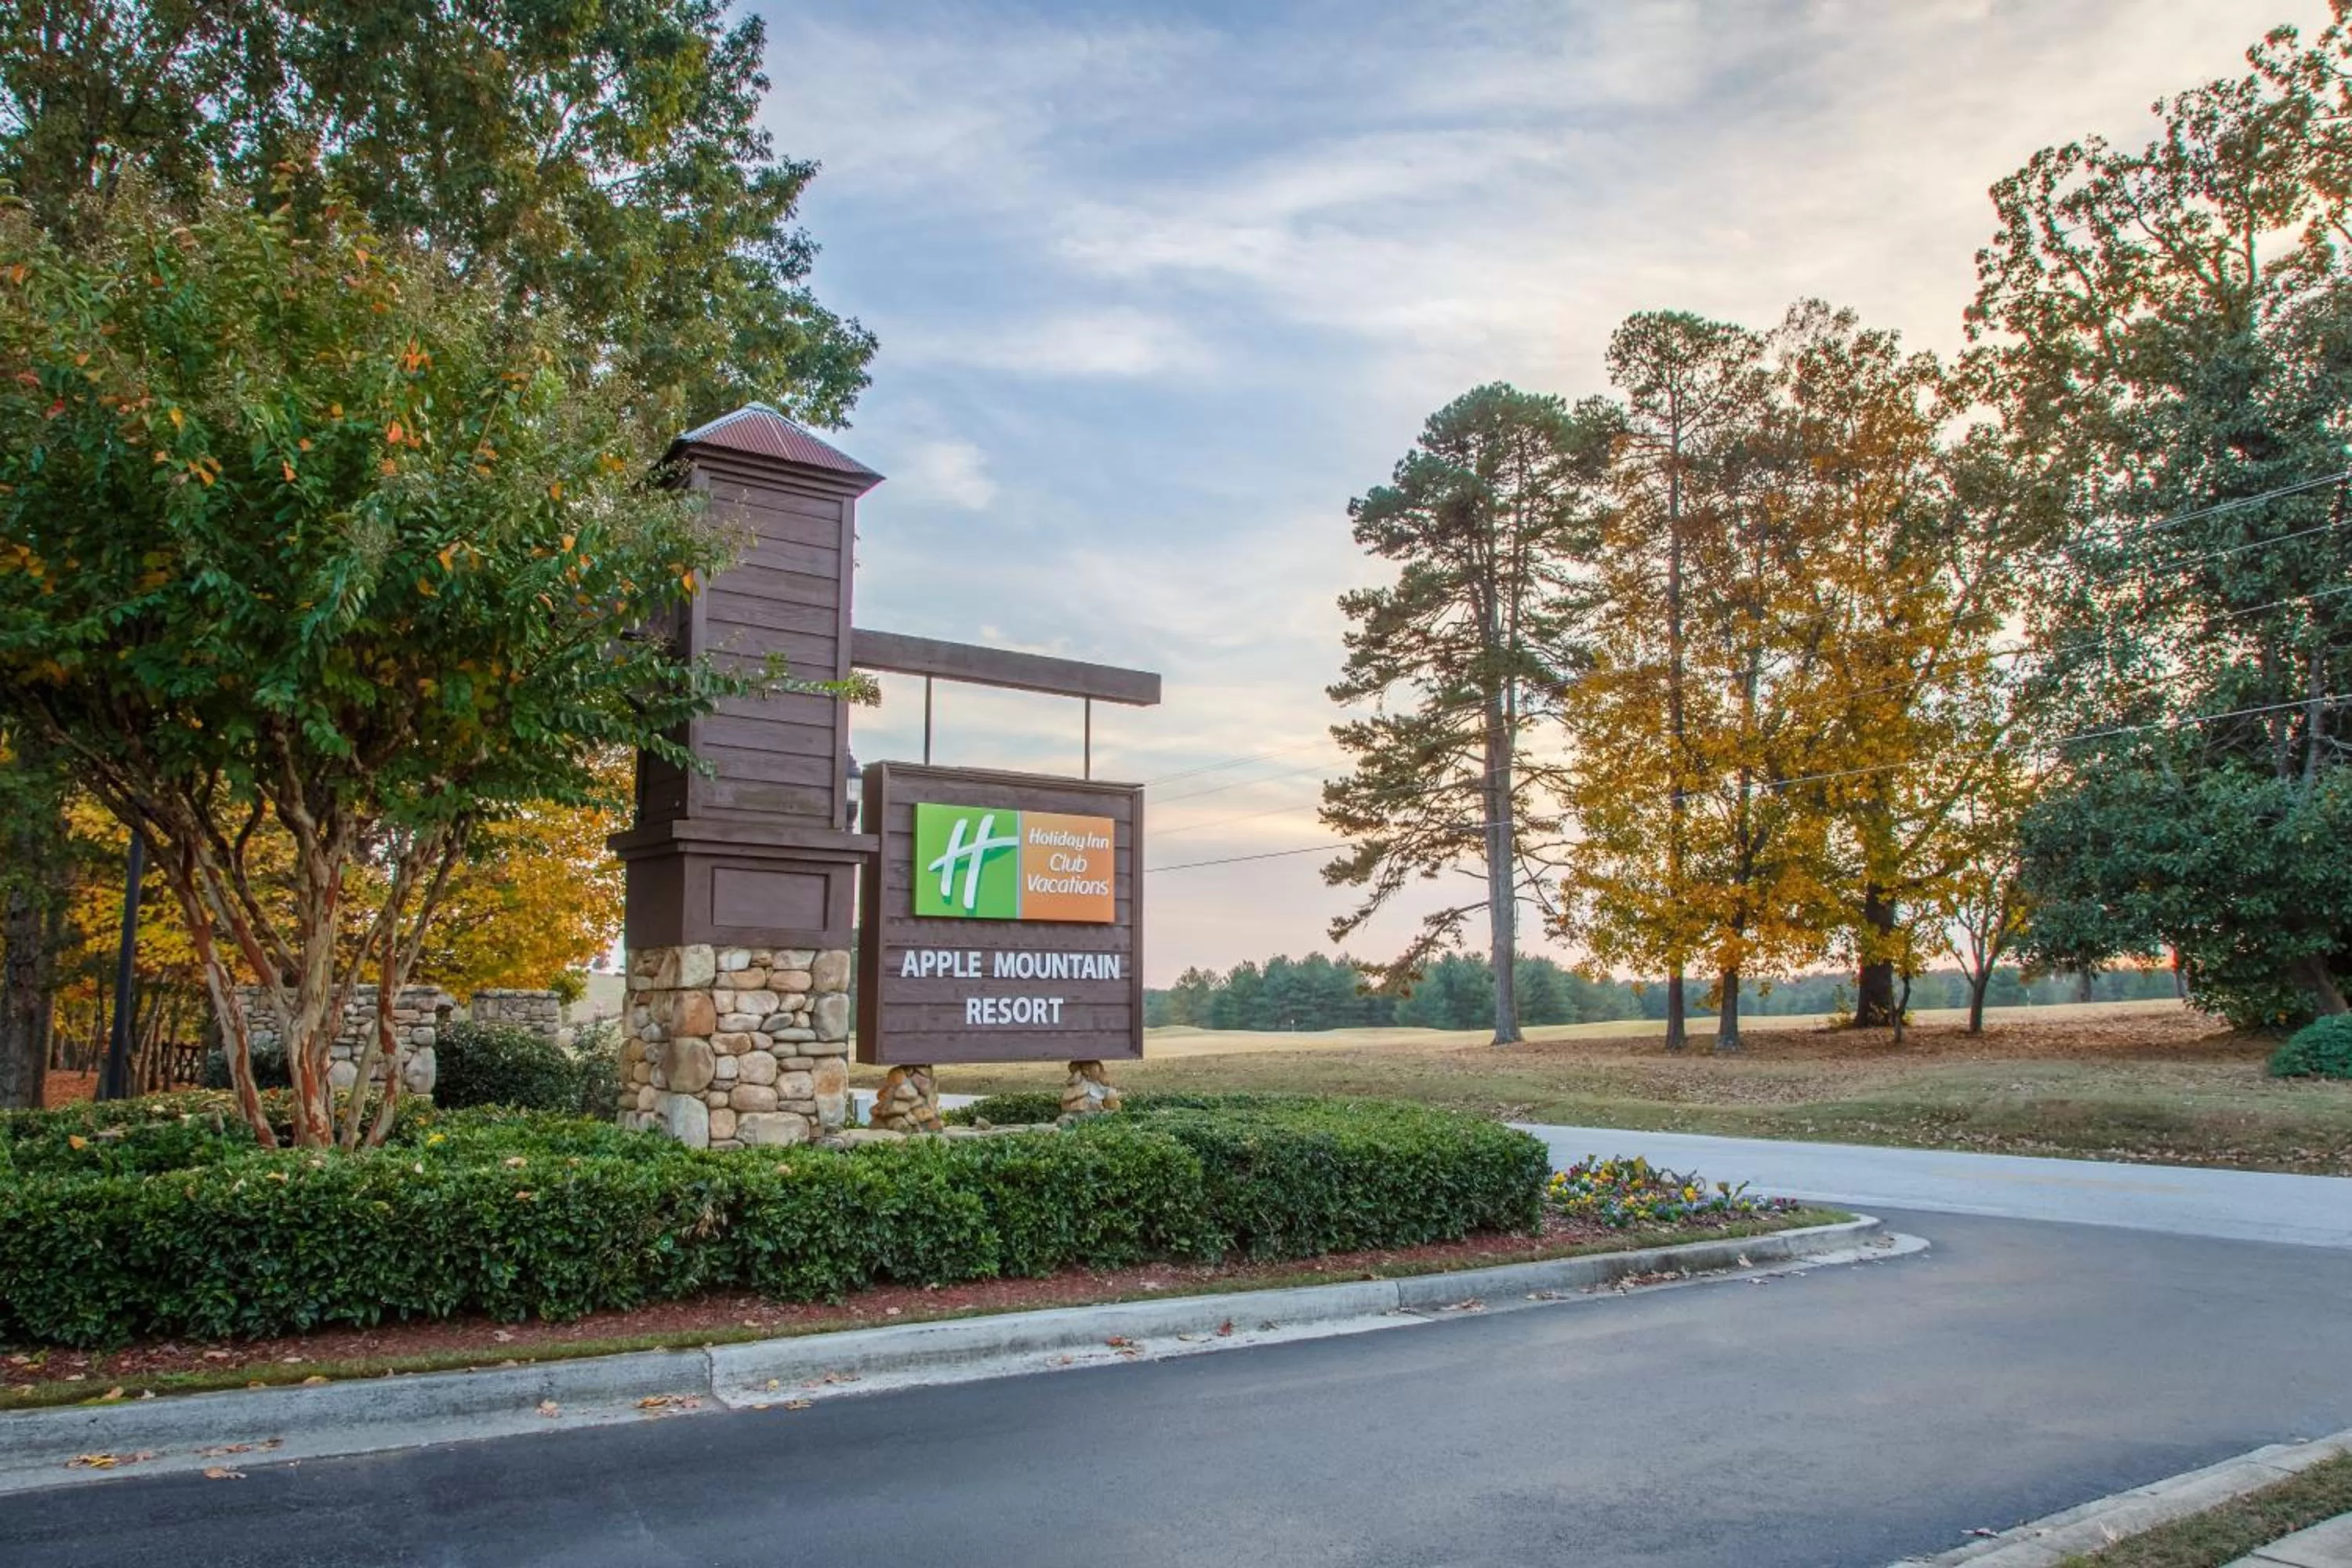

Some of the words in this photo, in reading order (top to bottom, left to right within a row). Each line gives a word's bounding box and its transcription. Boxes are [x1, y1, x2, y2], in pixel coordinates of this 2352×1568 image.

[1029, 827, 1084, 851] Holiday
[1086, 831, 1109, 849] Inn
[1049, 853, 1088, 873] Club
[1028, 874, 1109, 895] Vacations
[901, 950, 982, 978] APPLE
[993, 951, 1120, 979] MOUNTAIN
[965, 997, 1064, 1025] RESORT
